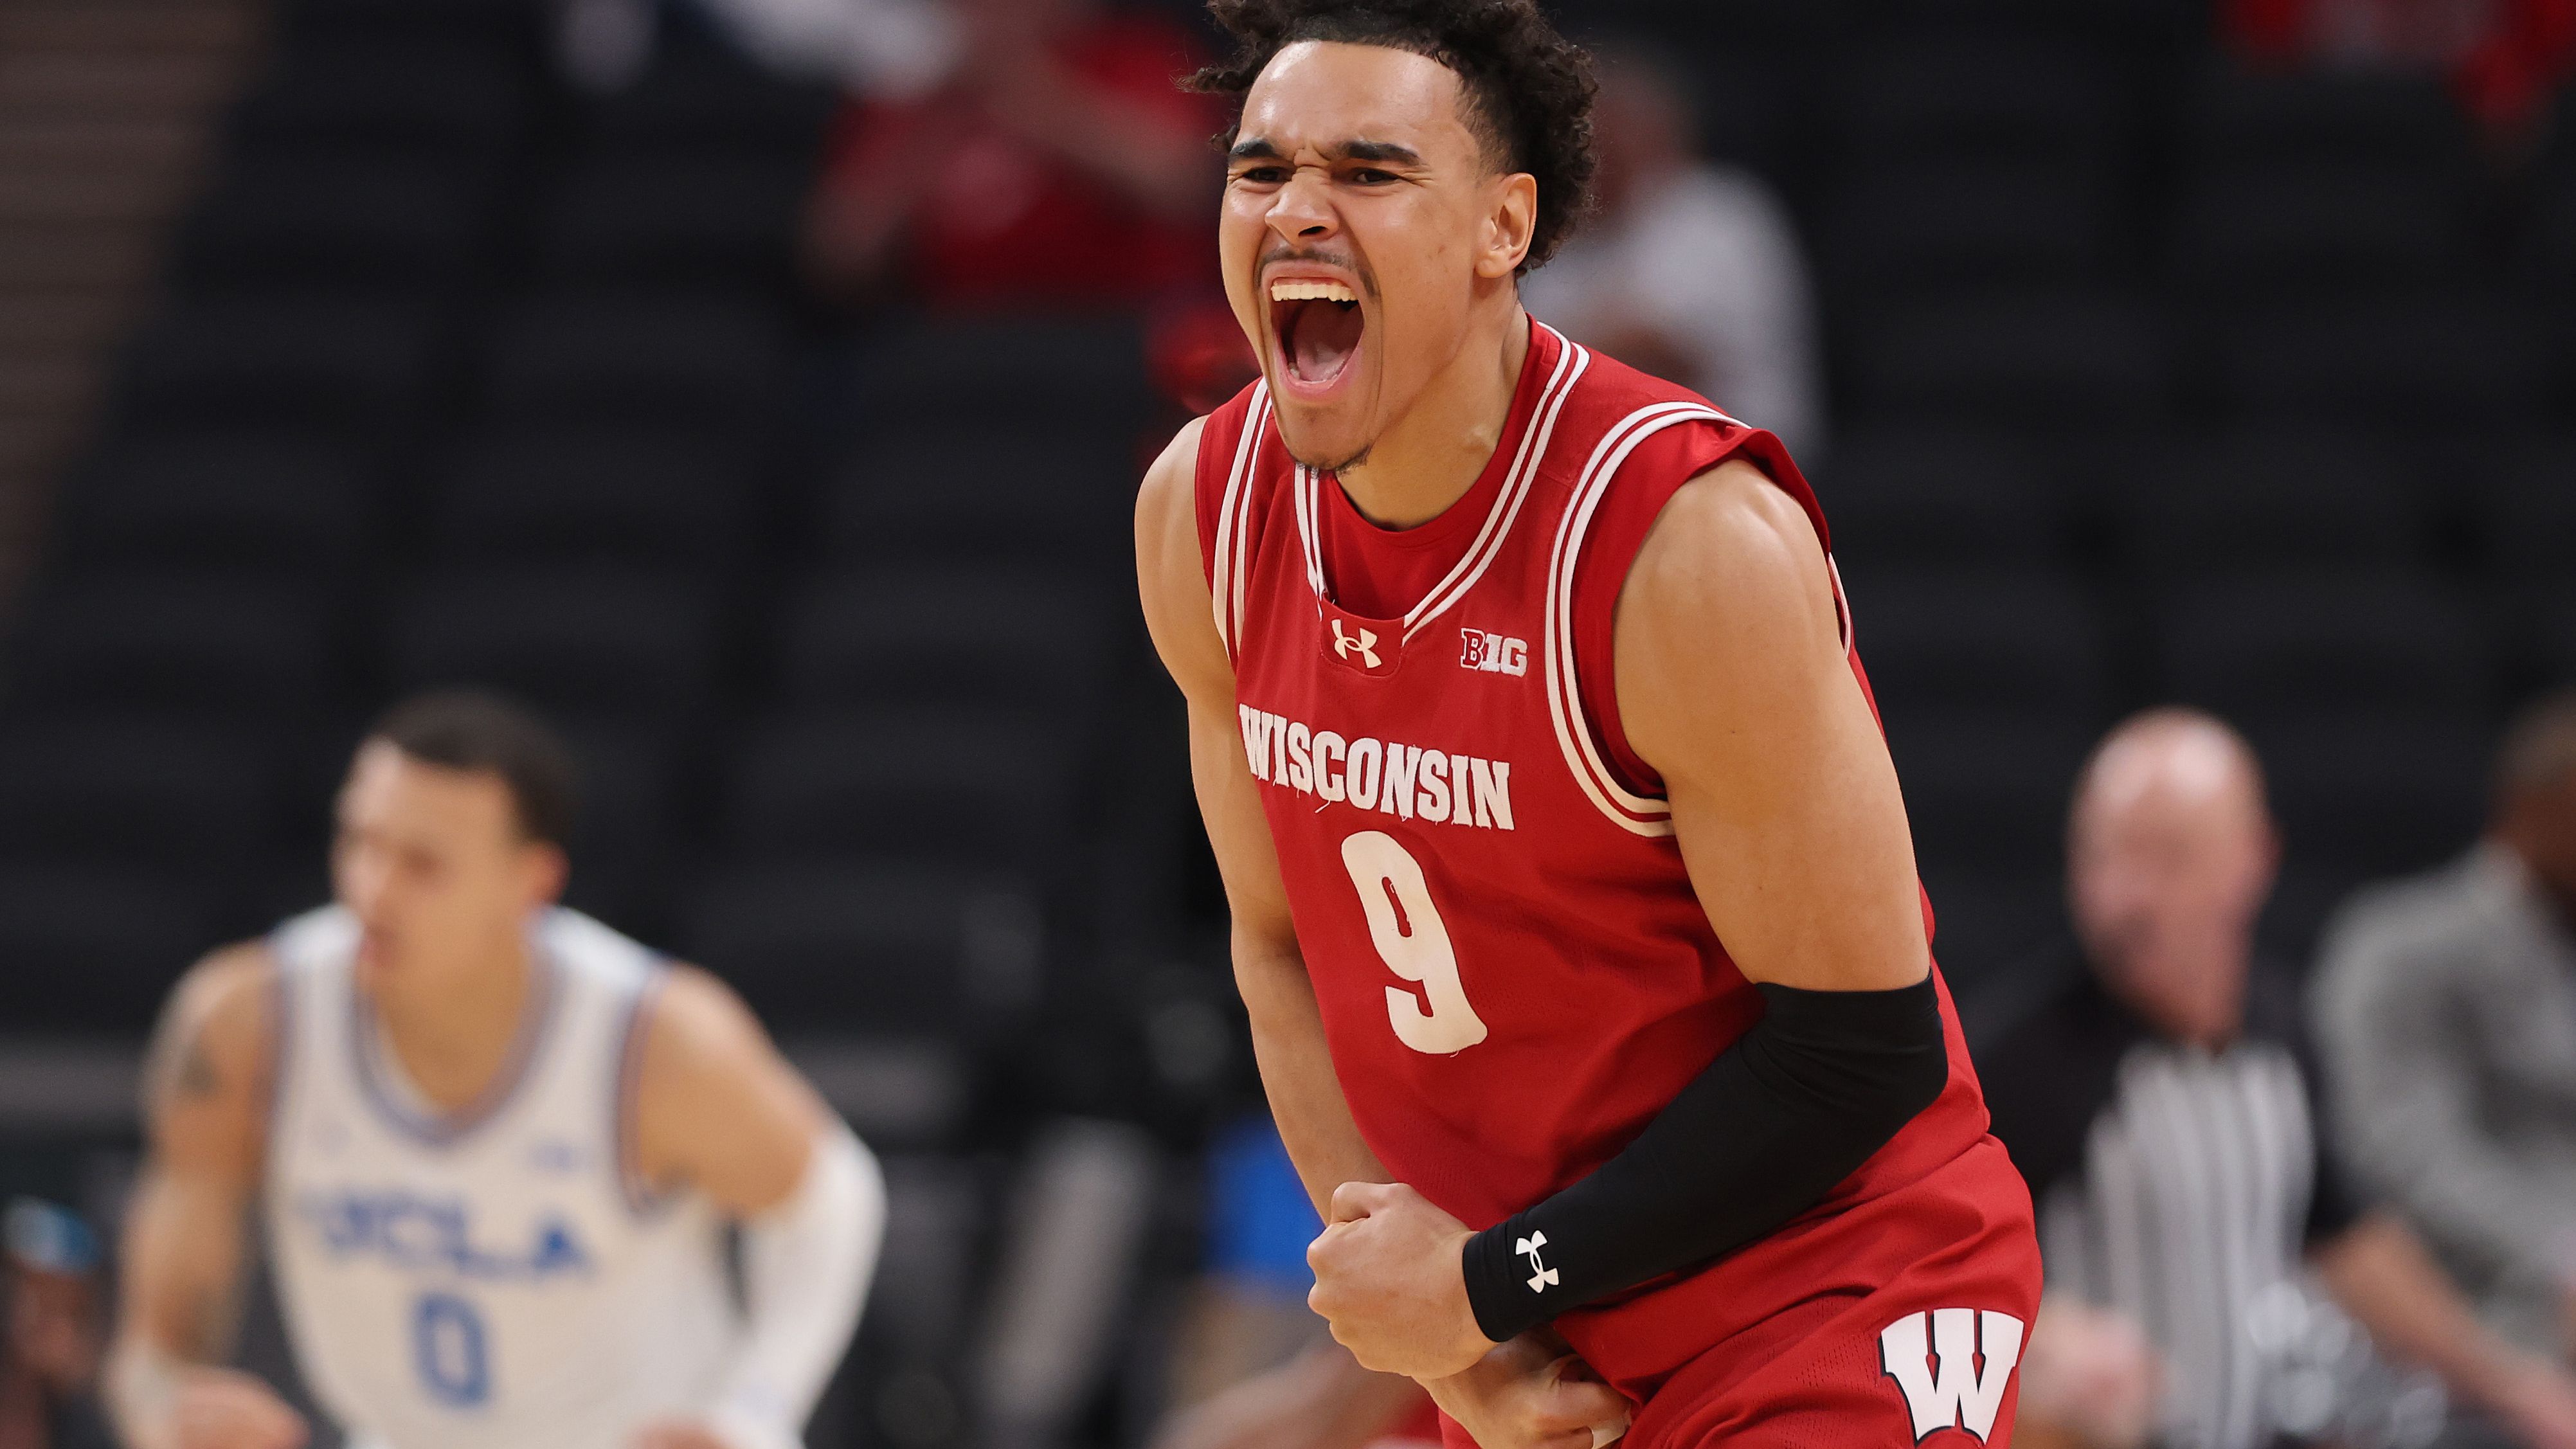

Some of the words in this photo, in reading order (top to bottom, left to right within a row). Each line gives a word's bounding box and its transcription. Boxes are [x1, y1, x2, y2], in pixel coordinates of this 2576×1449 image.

[1239, 703, 1515, 831] WISCONSIN
[1341, 830, 1488, 1055] 9
[298, 1189, 595, 1279] UCLA
[411, 1291, 492, 1409] 0
[1877, 1307, 2024, 1446] W
